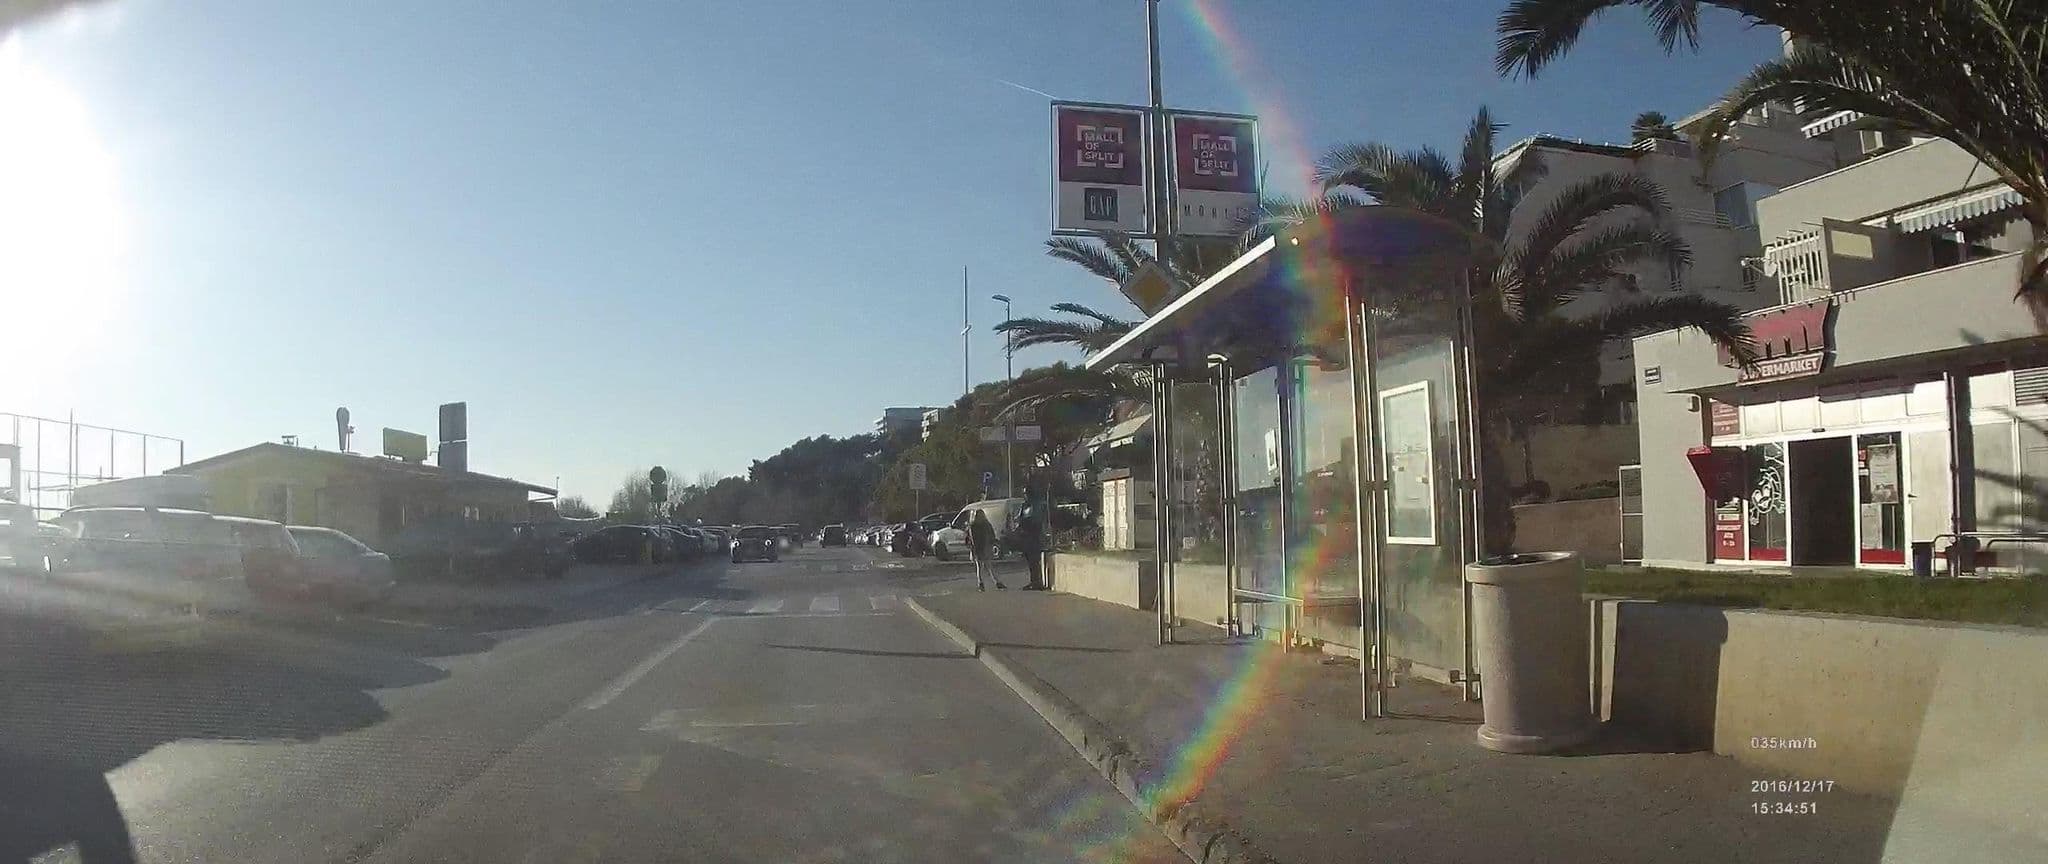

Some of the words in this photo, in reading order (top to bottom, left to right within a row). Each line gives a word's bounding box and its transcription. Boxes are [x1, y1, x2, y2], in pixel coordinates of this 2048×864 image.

[1085, 132, 1115, 142] MALL
[1085, 142, 1099, 150] OF
[1200, 140, 1230, 151] MALL
[1085, 151, 1114, 160] SPLIT
[1200, 150, 1215, 158] OF
[1200, 159, 1230, 168] SPLIT
[1090, 195, 1112, 215] GAP
[983, 471, 993, 483] P
